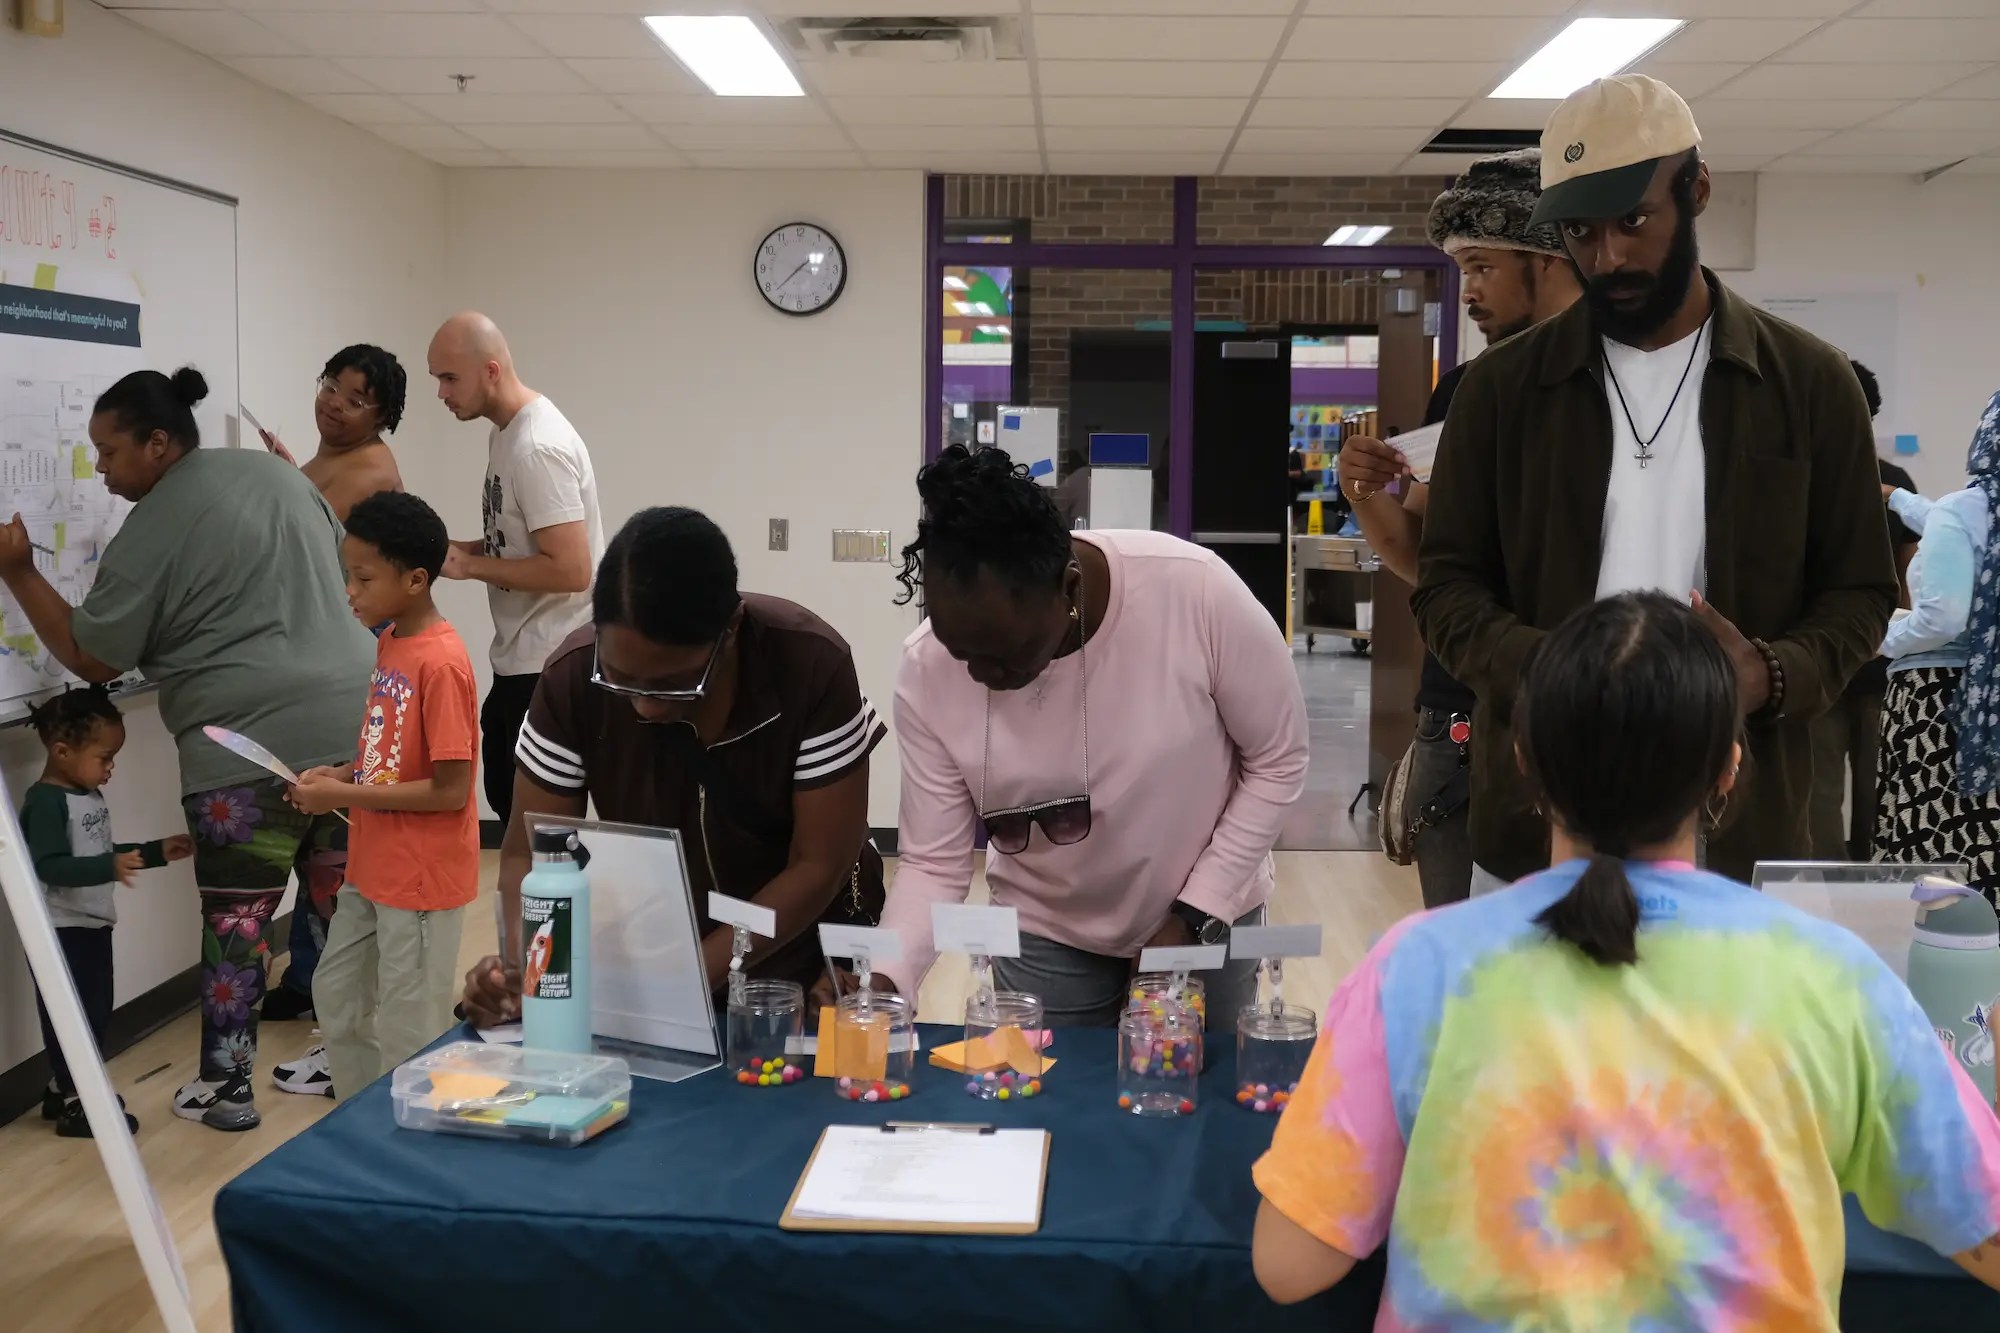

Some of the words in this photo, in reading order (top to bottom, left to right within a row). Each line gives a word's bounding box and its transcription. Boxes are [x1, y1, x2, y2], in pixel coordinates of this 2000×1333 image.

[778, 232, 785, 241] 11
[796, 227, 805, 237] 12
[765, 245, 774, 255] 10
[828, 246, 834, 255] 2
[760, 264, 766, 274] 9
[832, 265, 839, 275] 3
[765, 282, 771, 292] 8
[827, 283, 833, 292] 4
[778, 295, 784, 304] 7
[814, 296, 820, 305] 5
[796, 301, 802, 310] 6
[4, 302, 52, 320] neighborhood
[53, 308, 70, 323] that's
[71, 312, 106, 329] meaningful
[107, 316, 113, 327] to
[112, 317, 127, 331] you?
[525, 898, 554, 910] RIGHT
[525, 912, 549, 922] RESIST
[540, 974, 568, 984] RIGHT
[540, 989, 570, 998] RETURN
